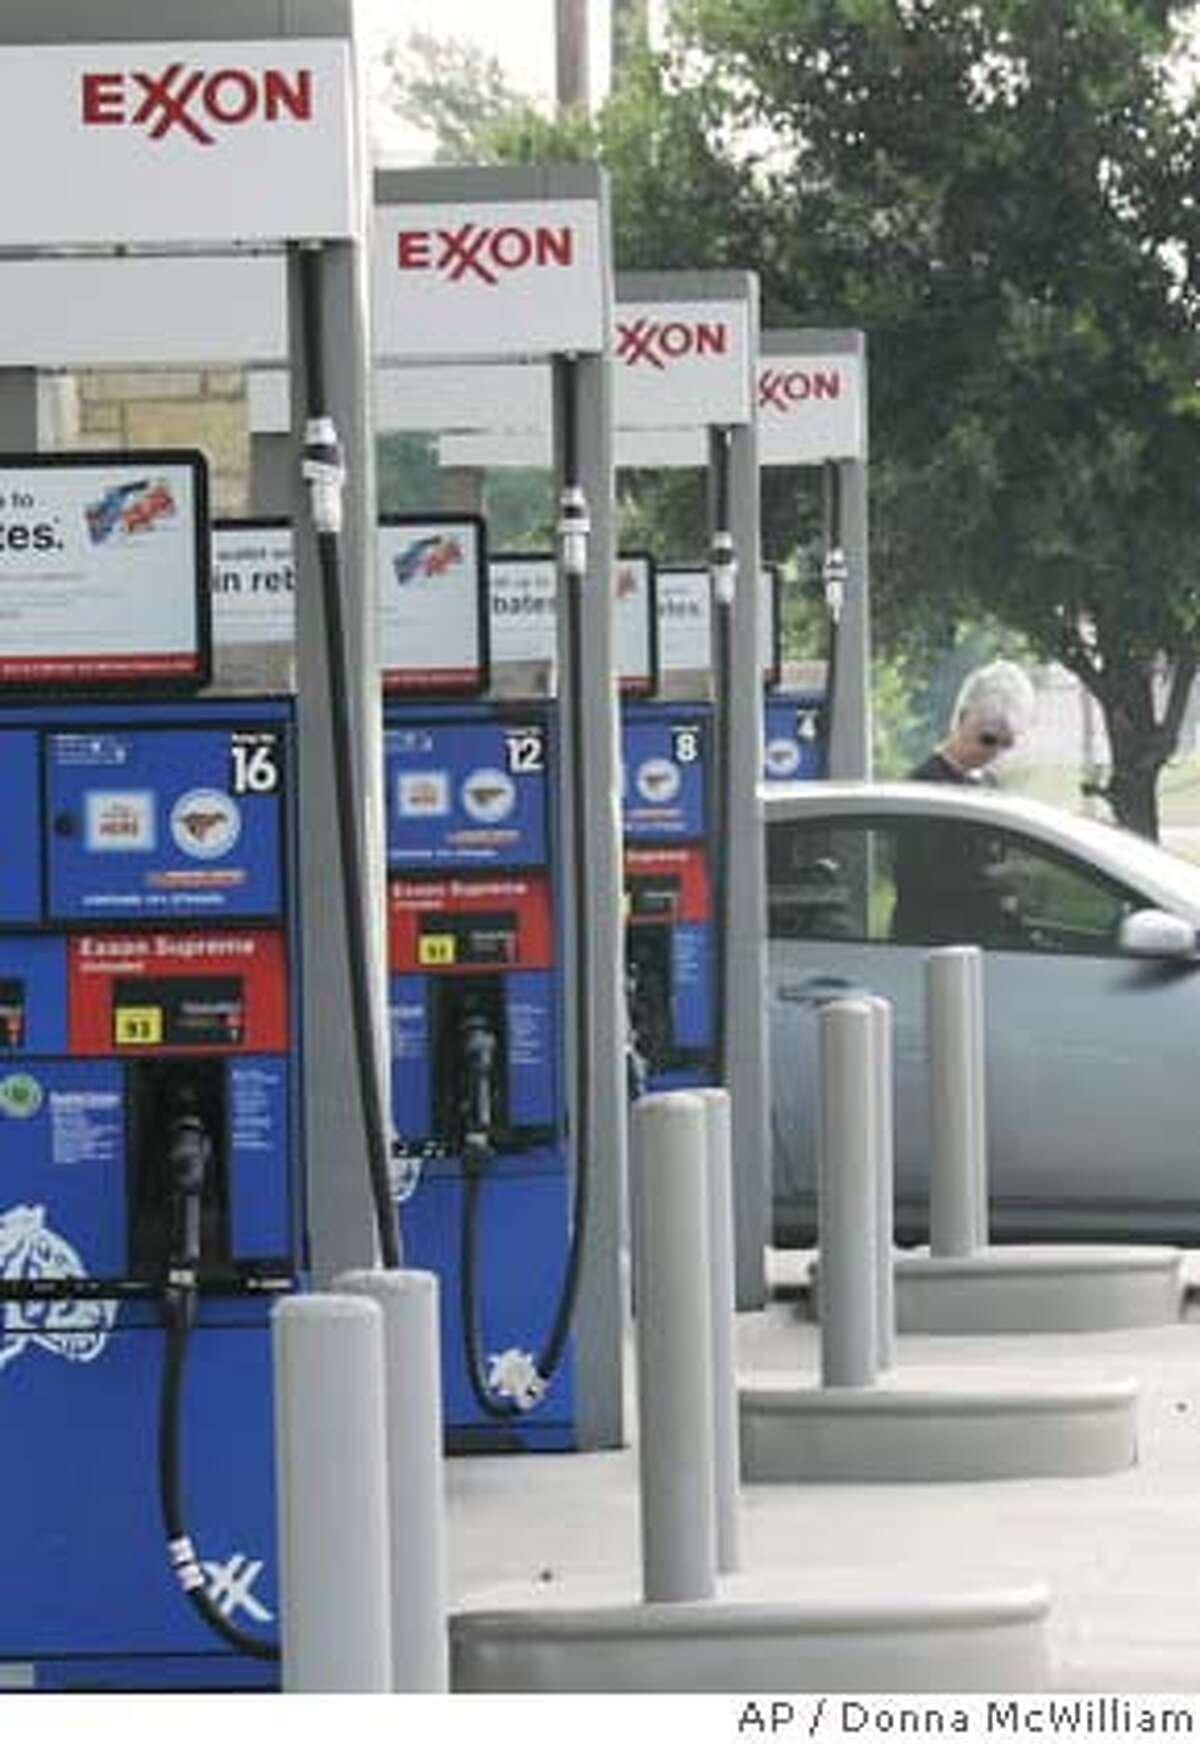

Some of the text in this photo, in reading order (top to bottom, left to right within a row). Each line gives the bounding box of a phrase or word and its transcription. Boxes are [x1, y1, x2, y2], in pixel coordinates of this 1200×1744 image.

[82, 63, 312, 145] EXXON
[398, 224, 573, 285] EXXON
[799, 716, 816, 738] 4
[506, 738, 543, 772] 12
[676, 733, 697, 762] 8
[231, 746, 277, 793] 16
[153, 937, 255, 959] Supreme
